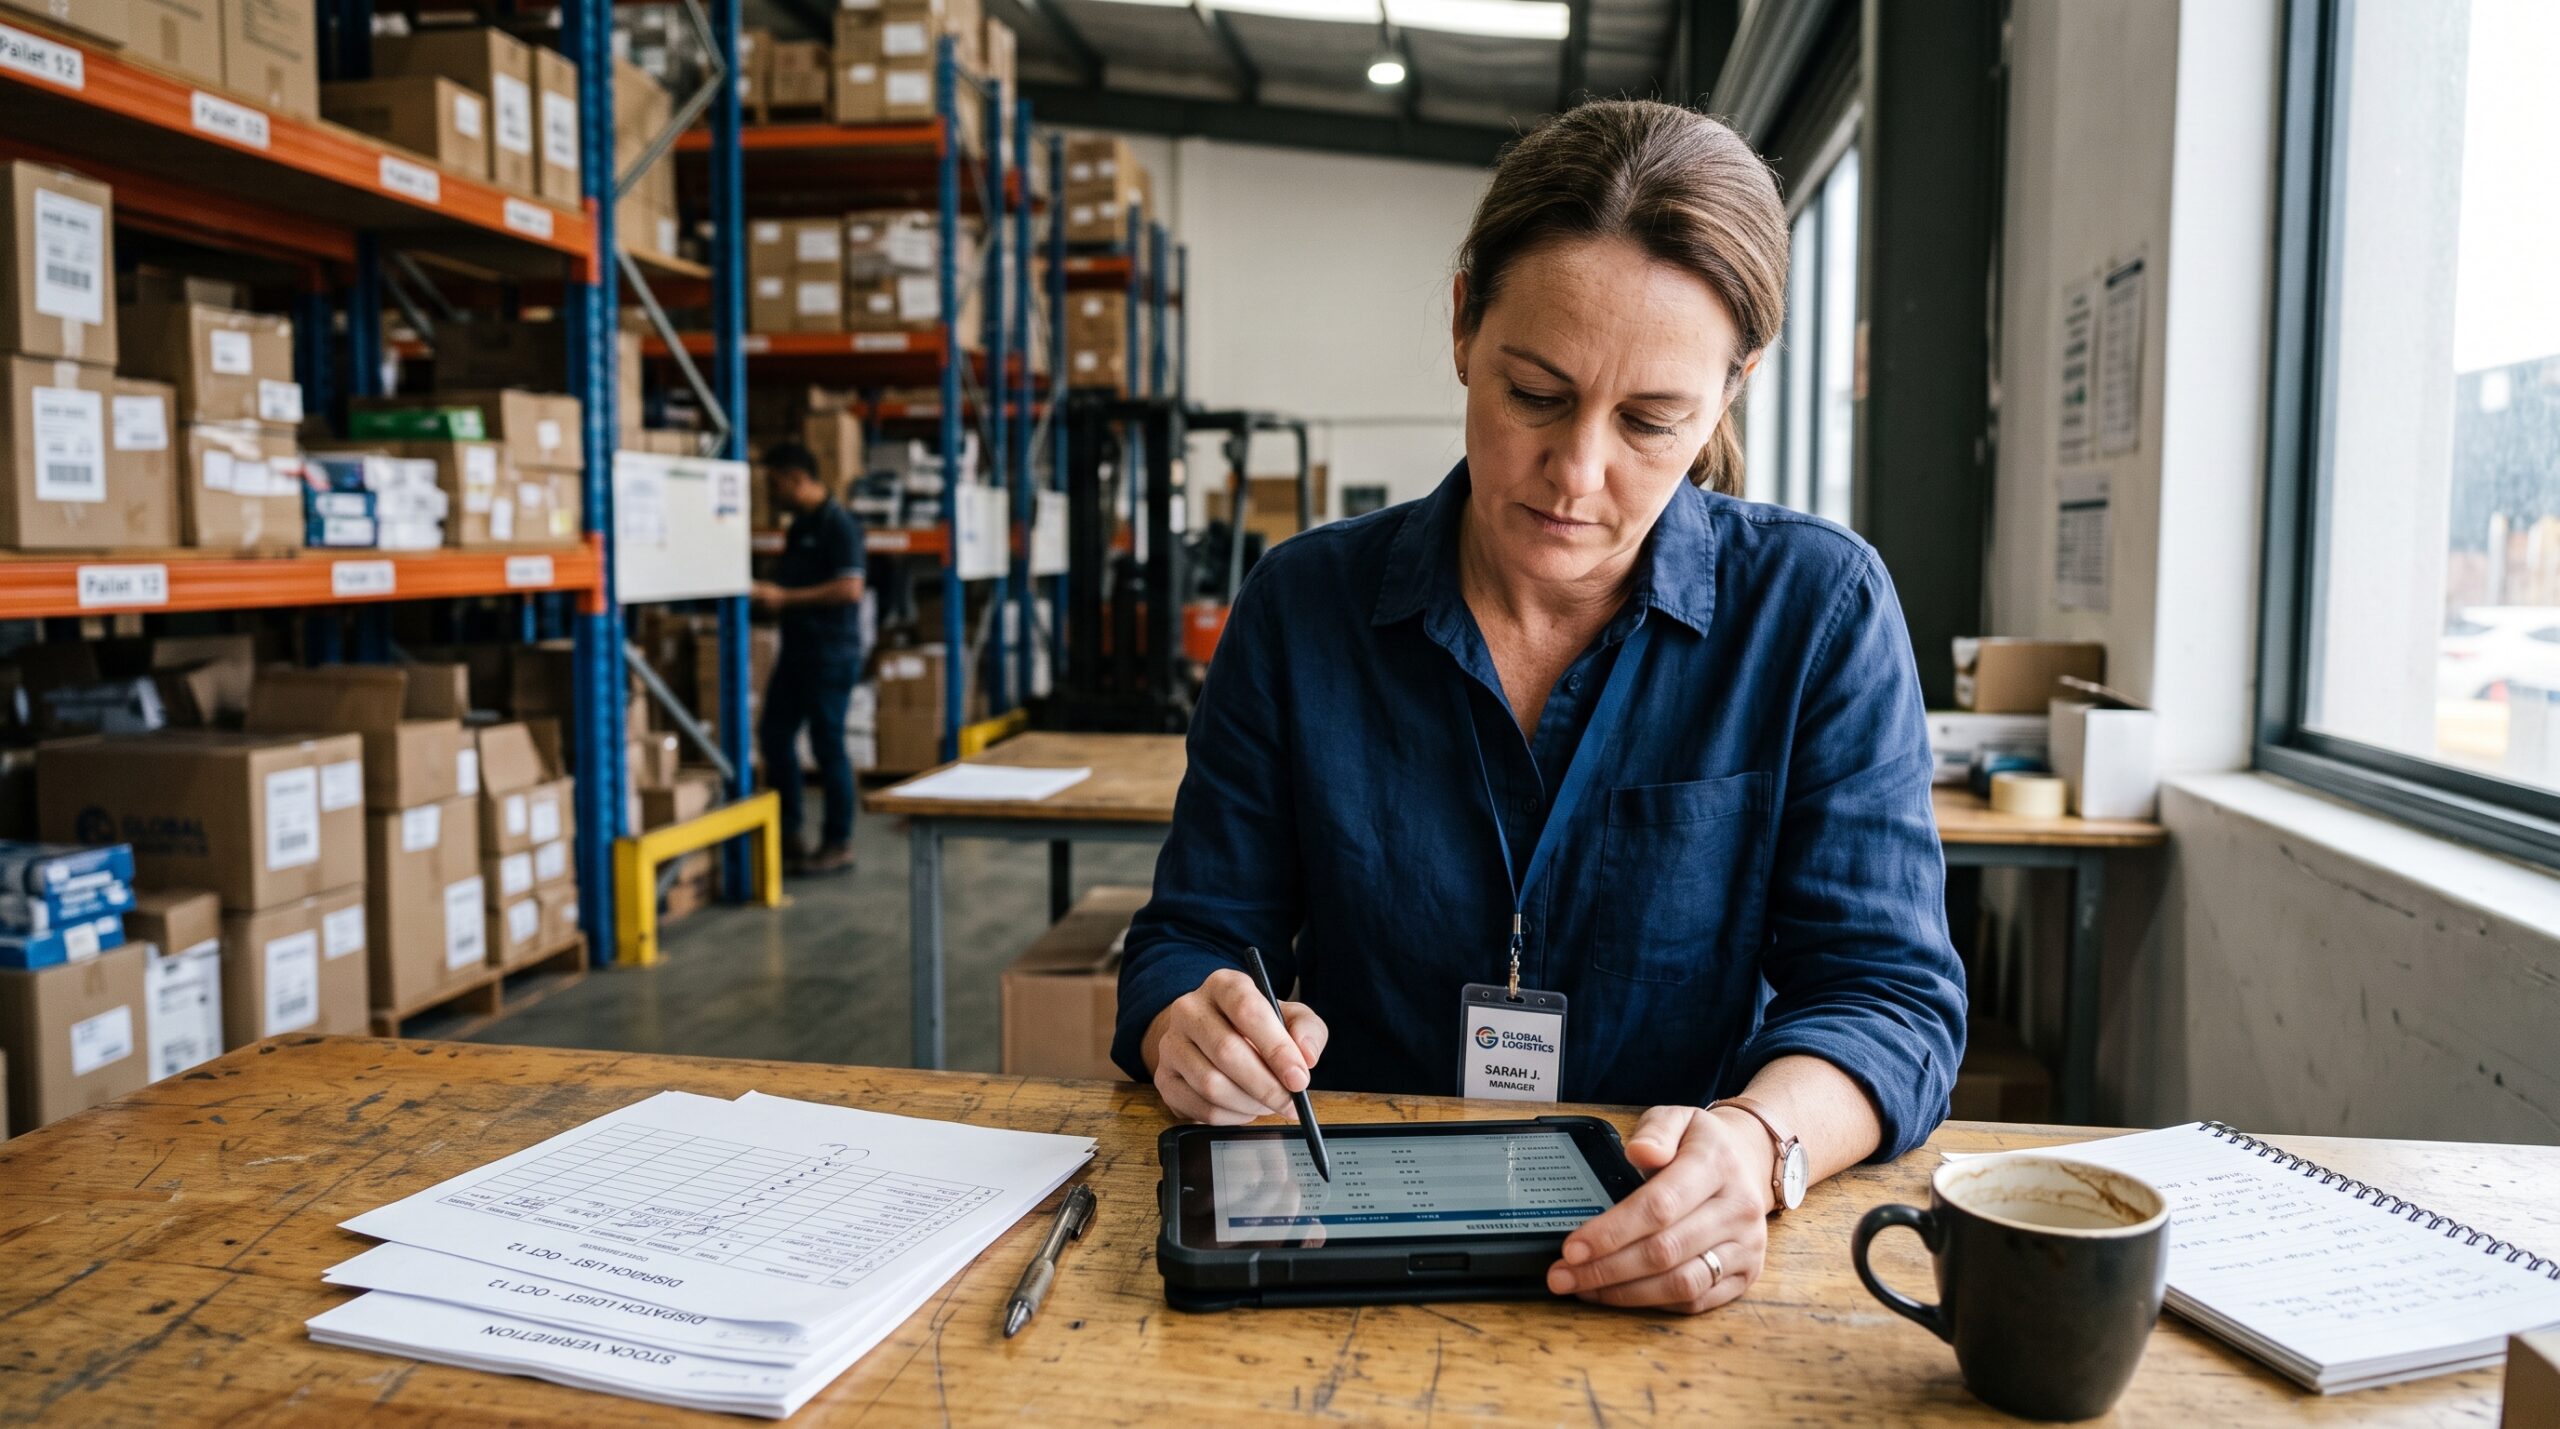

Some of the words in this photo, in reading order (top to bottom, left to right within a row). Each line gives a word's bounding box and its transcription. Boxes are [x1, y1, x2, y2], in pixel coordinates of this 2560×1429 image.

[1503, 1031, 1542, 1042] GLOBAL
[1503, 1041, 1554, 1053] LOGISTICS
[1485, 1064, 1528, 1079] SARAH
[1530, 1070, 1541, 1080] J.
[1489, 1080, 1535, 1092] MANAGER
[506, 1242, 529, 1254] 12
[524, 1246, 563, 1261] OCT
[569, 1257, 610, 1271] LIST
[486, 1278, 511, 1290] 12
[508, 1283, 552, 1298] OCT
[615, 1303, 710, 1326] DISPATCH
[603, 1344, 678, 1366] STOCK
